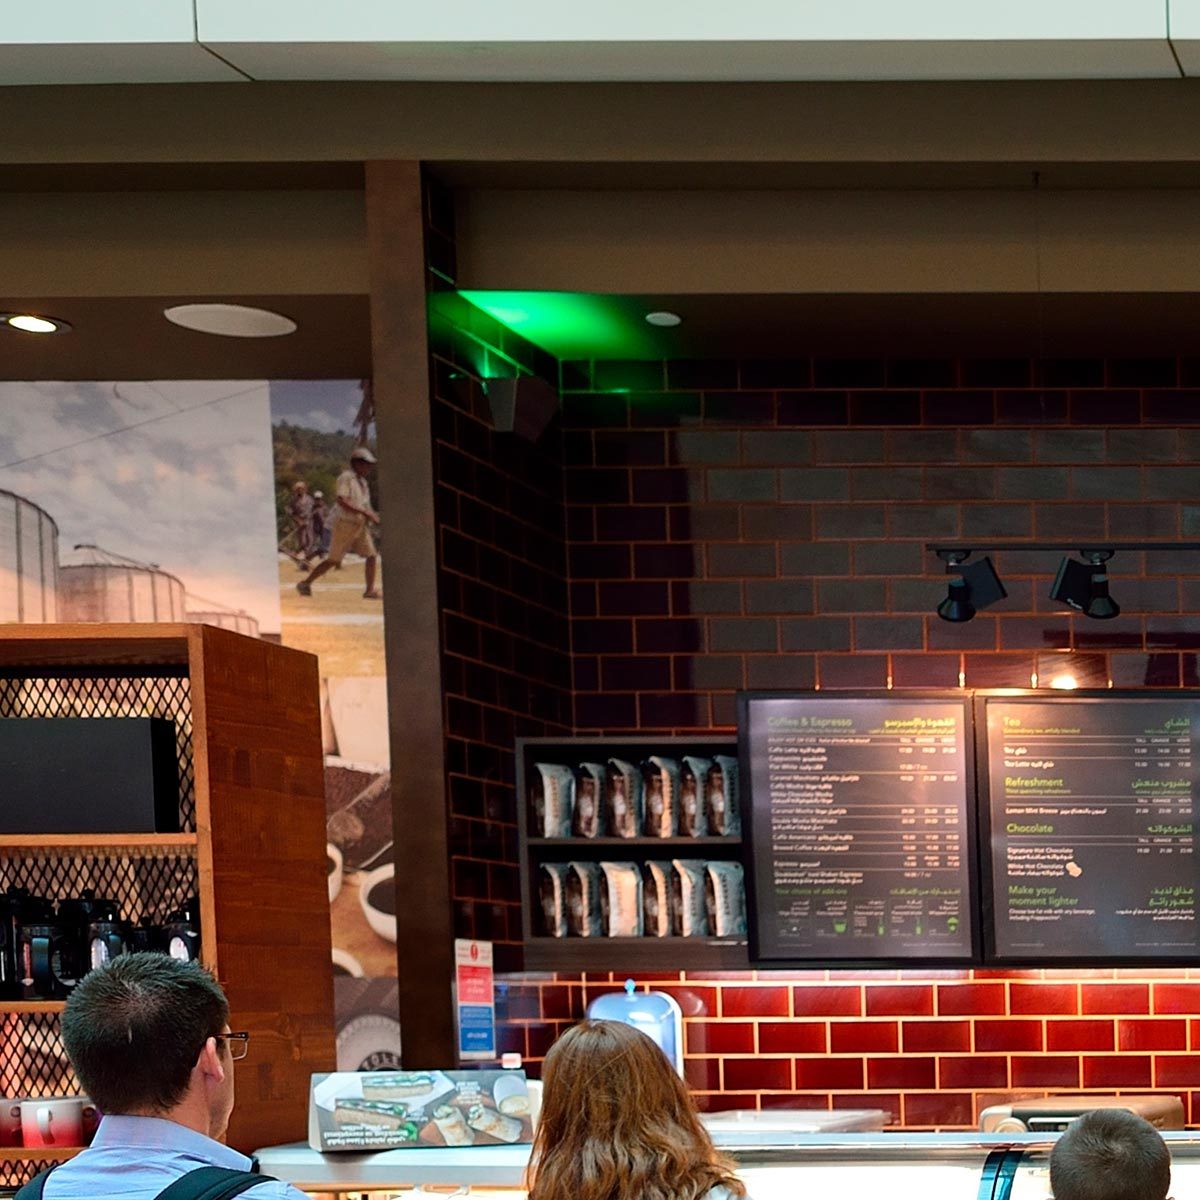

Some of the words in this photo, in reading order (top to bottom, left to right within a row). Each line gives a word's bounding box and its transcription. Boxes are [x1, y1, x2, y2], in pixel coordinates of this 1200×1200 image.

[768, 717, 800, 728] Coffee
[801, 717, 808, 728] &
[810, 717, 853, 729] Espresso
[1004, 717, 1021, 727] Tea
[1005, 778, 1063, 787] Refreshment
[1007, 824, 1054, 833] Chocolate
[1008, 886, 1034, 894] Make
[1036, 887, 1057, 896] your
[1049, 896, 1079, 907] lighter
